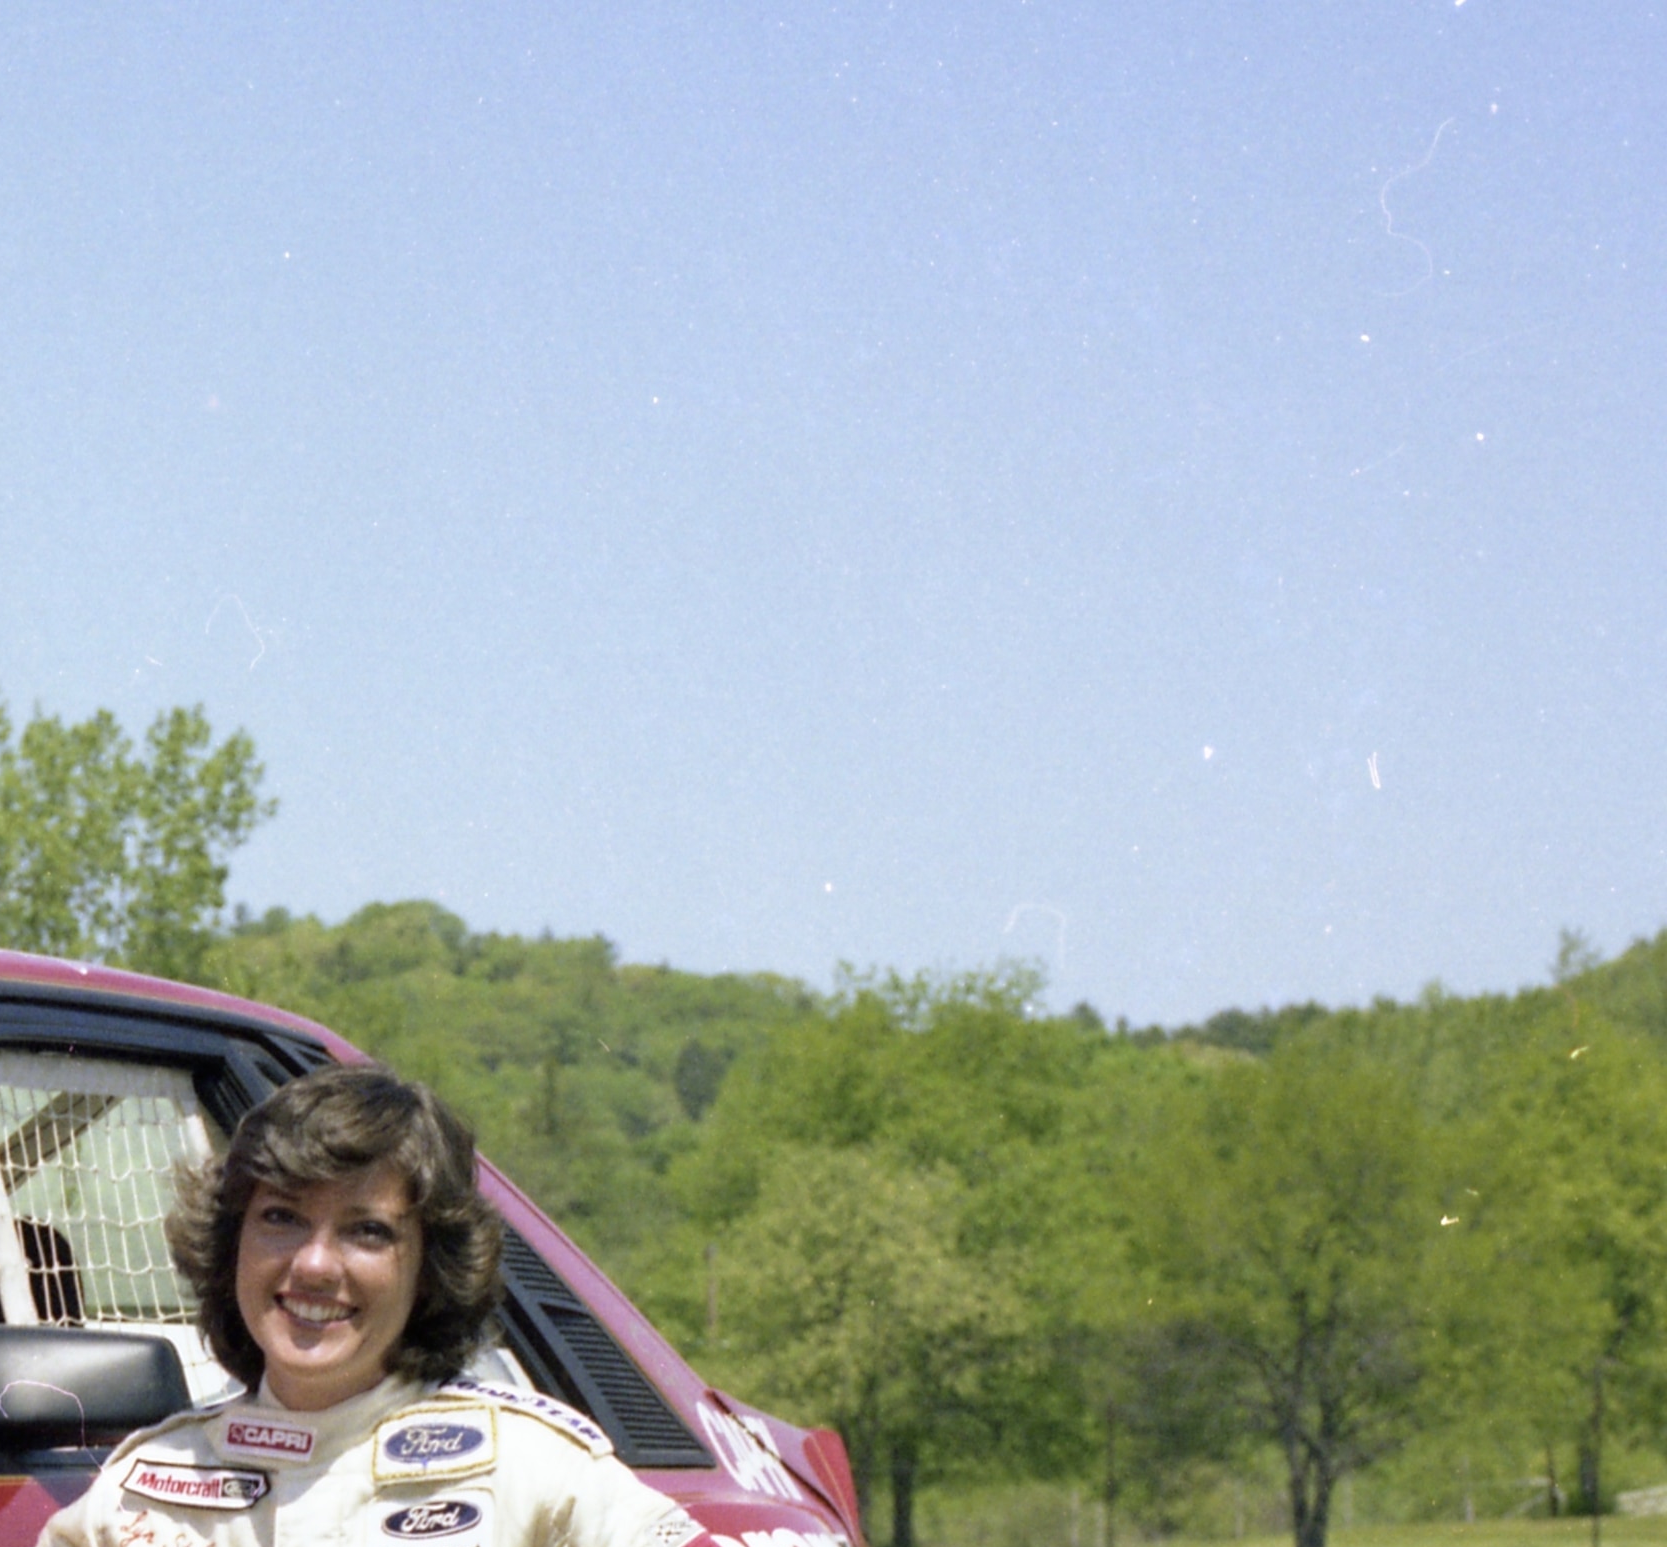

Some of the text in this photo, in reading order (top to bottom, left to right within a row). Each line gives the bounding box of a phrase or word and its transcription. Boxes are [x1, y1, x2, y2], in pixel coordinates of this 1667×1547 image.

[245, 1427, 309, 1450] CAPRI
[401, 1426, 464, 1455] Ford
[137, 1472, 221, 1498] Motorcraft
[401, 1501, 461, 1533] Ford
